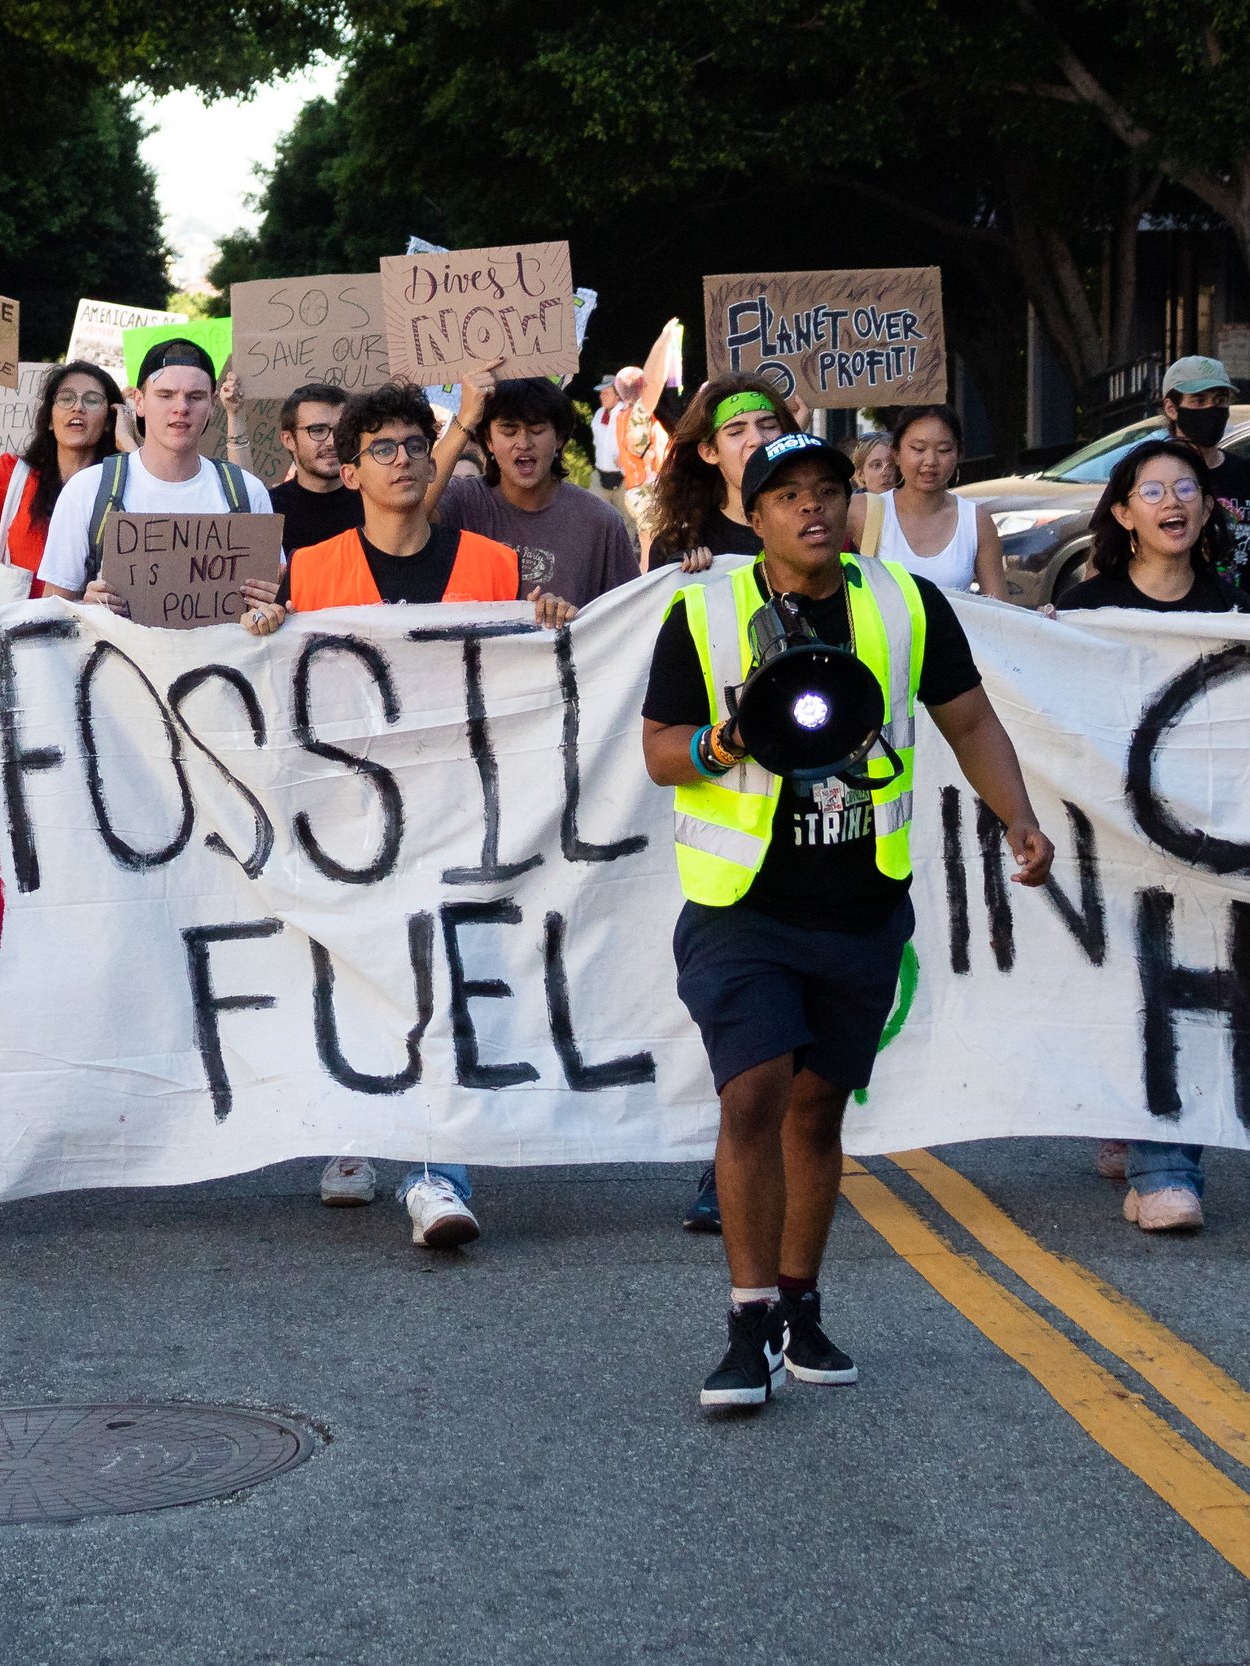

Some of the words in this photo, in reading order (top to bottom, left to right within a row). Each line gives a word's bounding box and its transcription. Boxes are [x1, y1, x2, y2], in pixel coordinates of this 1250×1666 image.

[403, 251, 546, 306] Divest
[268, 287, 370, 332] SOS
[411, 297, 564, 368] NOW
[248, 336, 318, 377] SAVE
[332, 334, 389, 361] OUR
[726, 295, 849, 372] PLANET
[853, 304, 927, 342] OVER
[818, 345, 918, 392] PROFIT!
[117, 519, 250, 555] DENIAL
[129, 563, 160, 586] IS
[189, 553, 250, 584] NOT
[162, 590, 249, 622] POLIC
[179, 897, 656, 1125] FUEL
